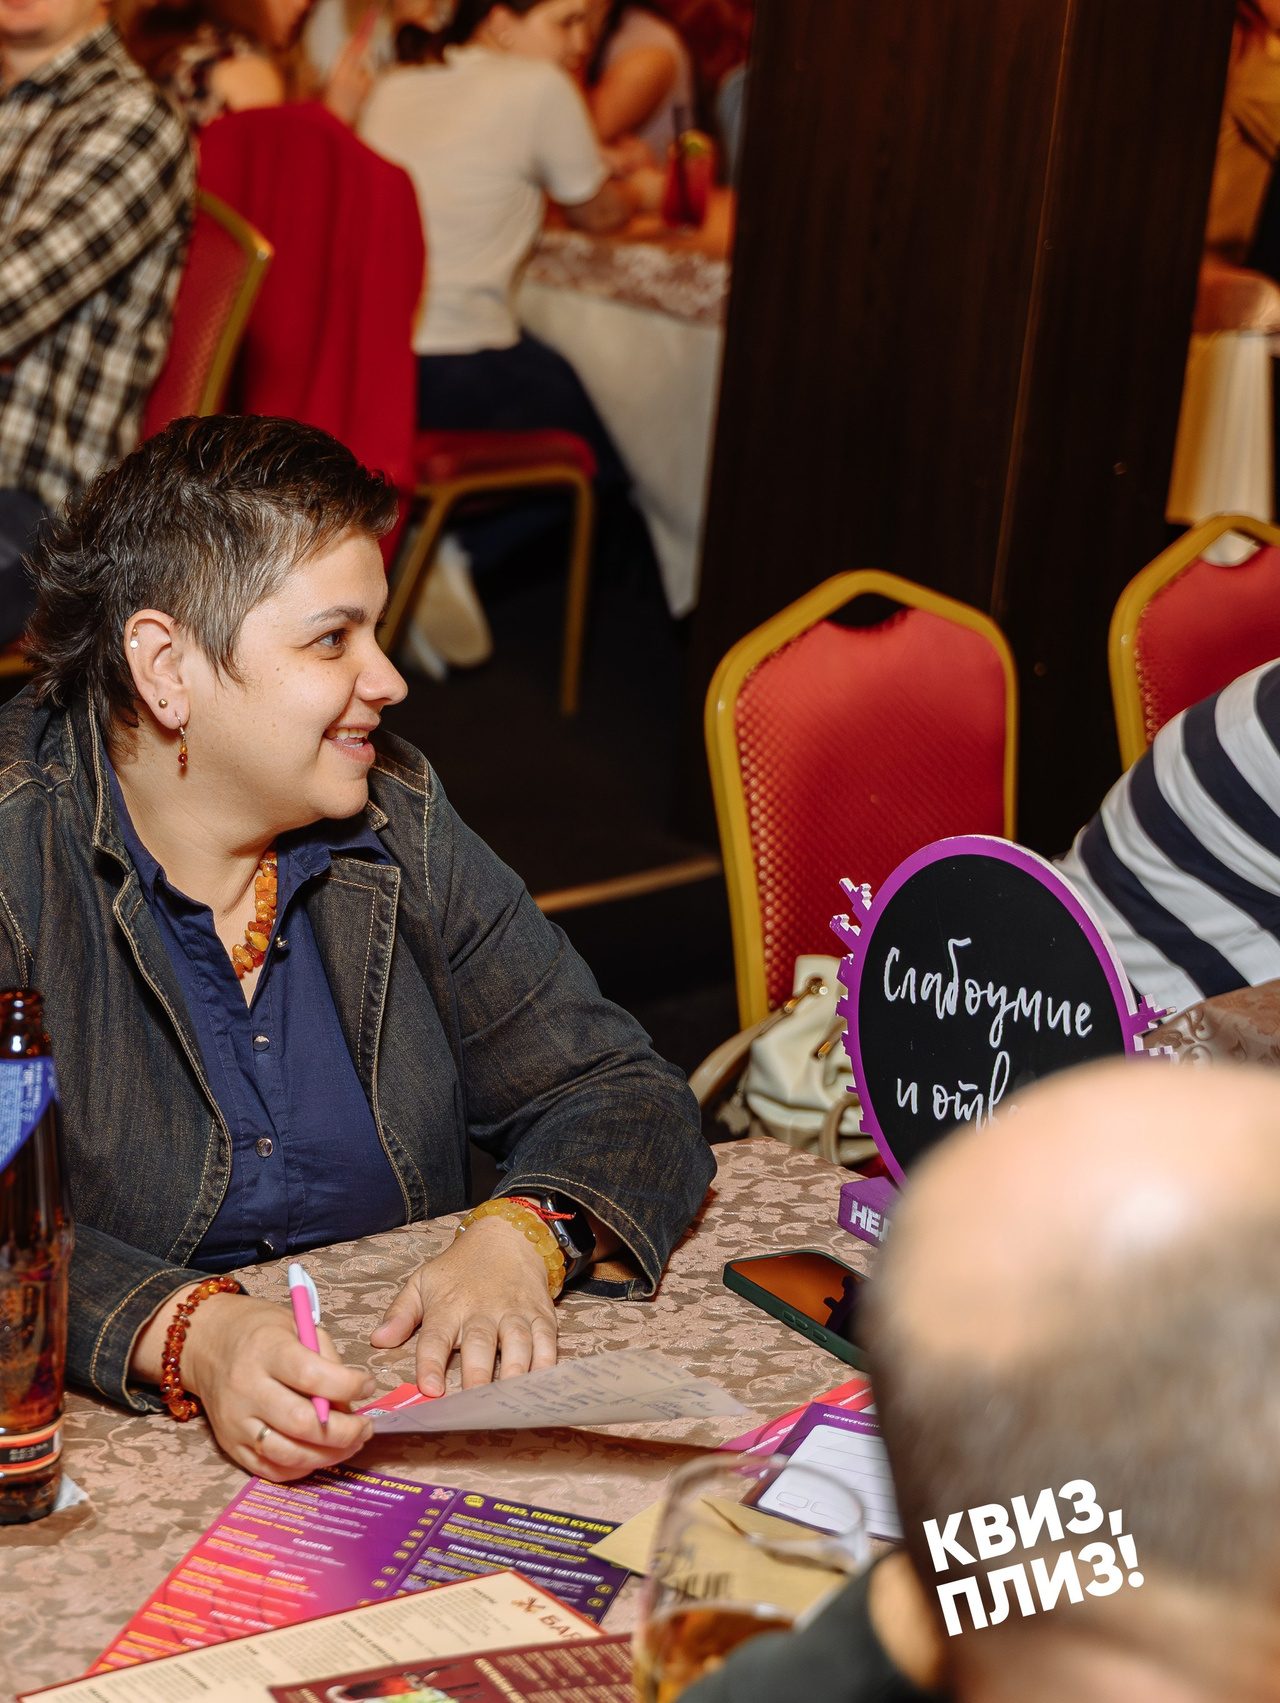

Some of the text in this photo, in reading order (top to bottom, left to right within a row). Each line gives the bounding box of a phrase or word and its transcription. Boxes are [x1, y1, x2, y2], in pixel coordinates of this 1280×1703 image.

[884, 937, 1093, 1048] Слабоумие
[896, 1051, 1016, 1136] и отв
[363, 1487, 405, 1501] ЗАКУСКИ
[381, 1480, 423, 1494] КУХНЯ
[493, 1503, 529, 1517] КВИЗ,
[569, 1519, 614, 1533] КУХНЯ
[507, 1517, 585, 1540] ГОРЯЧИЕ БЛЮДА
[447, 1544, 487, 1559] ПИВНЫЕ
